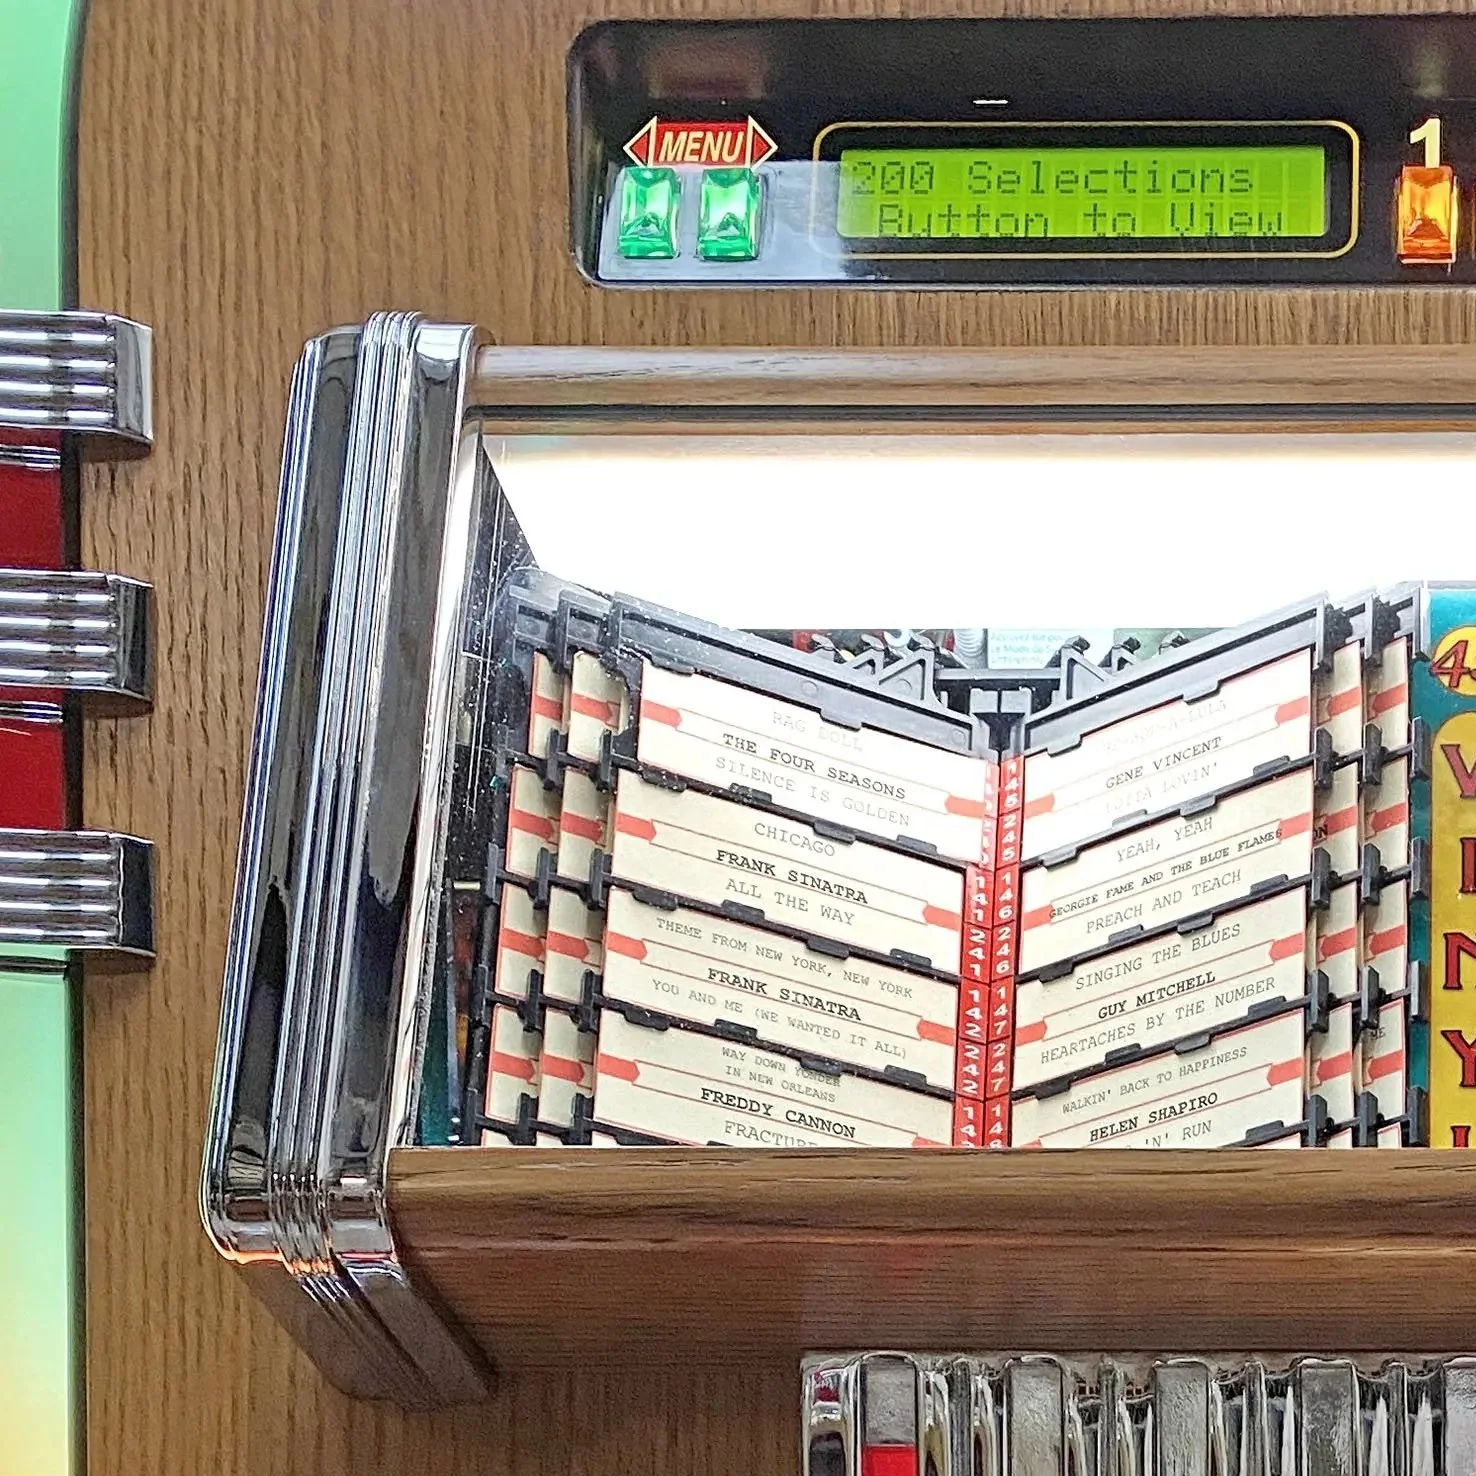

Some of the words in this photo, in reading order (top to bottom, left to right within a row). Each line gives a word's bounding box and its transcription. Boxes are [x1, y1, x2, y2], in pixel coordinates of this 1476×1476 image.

[658, 130, 745, 163] MENU
[1409, 118, 1444, 167] 1
[852, 160, 934, 194] 200
[968, 159, 1254, 194] Selections
[878, 203, 1051, 237] Button
[1084, 203, 1136, 236] to
[1167, 203, 1285, 236] View
[723, 733, 757, 755] THE
[770, 748, 815, 773] FOUR
[827, 767, 906, 799] SEASONS
[1106, 766, 1143, 789] GENE
[1153, 736, 1222, 770] VINCENT
[715, 757, 796, 792] SILENCE
[809, 786, 830, 803] IS
[842, 797, 909, 827] GOLDEN
[754, 823, 836, 857] CHICAGO
[1116, 839, 1161, 862] YEAH,
[1174, 817, 1214, 842] YEAH
[716, 850, 777, 877] FRANK
[788, 867, 866, 901] SINATRA
[1049, 893, 1099, 919] GEORGIE
[1105, 880, 1135, 898] FAME
[1141, 871, 1163, 888] AND
[1170, 860, 1194, 876] THE
[1199, 847, 1230, 866] BLUE
[725, 878, 762, 899] ALL
[774, 891, 809, 913] THE
[820, 906, 855, 927] WAY
[1087, 905, 1143, 933] PREACH
[1152, 891, 1182, 911] AND
[1192, 869, 1241, 898] TEACH
[656, 918, 702, 940] THEME
[711, 932, 747, 953] FROM
[756, 944, 783, 962] NEW
[792, 955, 833, 977] YORK,
[843, 969, 870, 987] NEW
[879, 978, 913, 999] YORK
[1075, 959, 1143, 990] SINGING
[1152, 943, 1182, 964] THE
[1191, 924, 1241, 952] BLUES
[652, 979, 679, 995] YOU
[688, 989, 716, 1005] AND
[725, 999, 743, 1013] ME
[755, 1006, 779, 1023] (WE
[788, 1013, 841, 1040] WANTED
[849, 1032, 866, 1046] IT
[875, 1039, 906, 1059] ALL)
[707, 968, 768, 995] FRANK
[779, 988, 861, 1021] SINATRA
[1097, 1001, 1127, 1020] GUY
[1136, 972, 1216, 1007] MITCHELL
[1041, 1021, 1135, 1064] HEARTACHES
[1146, 1014, 1165, 1029] BY
[1175, 1001, 1206, 1020] THE
[1214, 977, 1275, 1007] NUMBER
[722, 1046, 747, 1061] WAY
[725, 1065, 741, 1077] IN
[748, 1070, 775, 1087] NEW
[781, 1078, 836, 1103] ORLEANS
[1061, 1089, 1112, 1114] WALKIN'
[1120, 1078, 1150, 1096] BACK
[1157, 1070, 1173, 1082] TO
[1179, 1047, 1247, 1077] HAPPINESS
[701, 1088, 773, 1117] FREDDY
[786, 1109, 856, 1138] CANNON
[1089, 1116, 1138, 1142] HELEN
[1148, 1093, 1218, 1122] SHAPIRO
[1182, 1120, 1212, 1139] RUN
